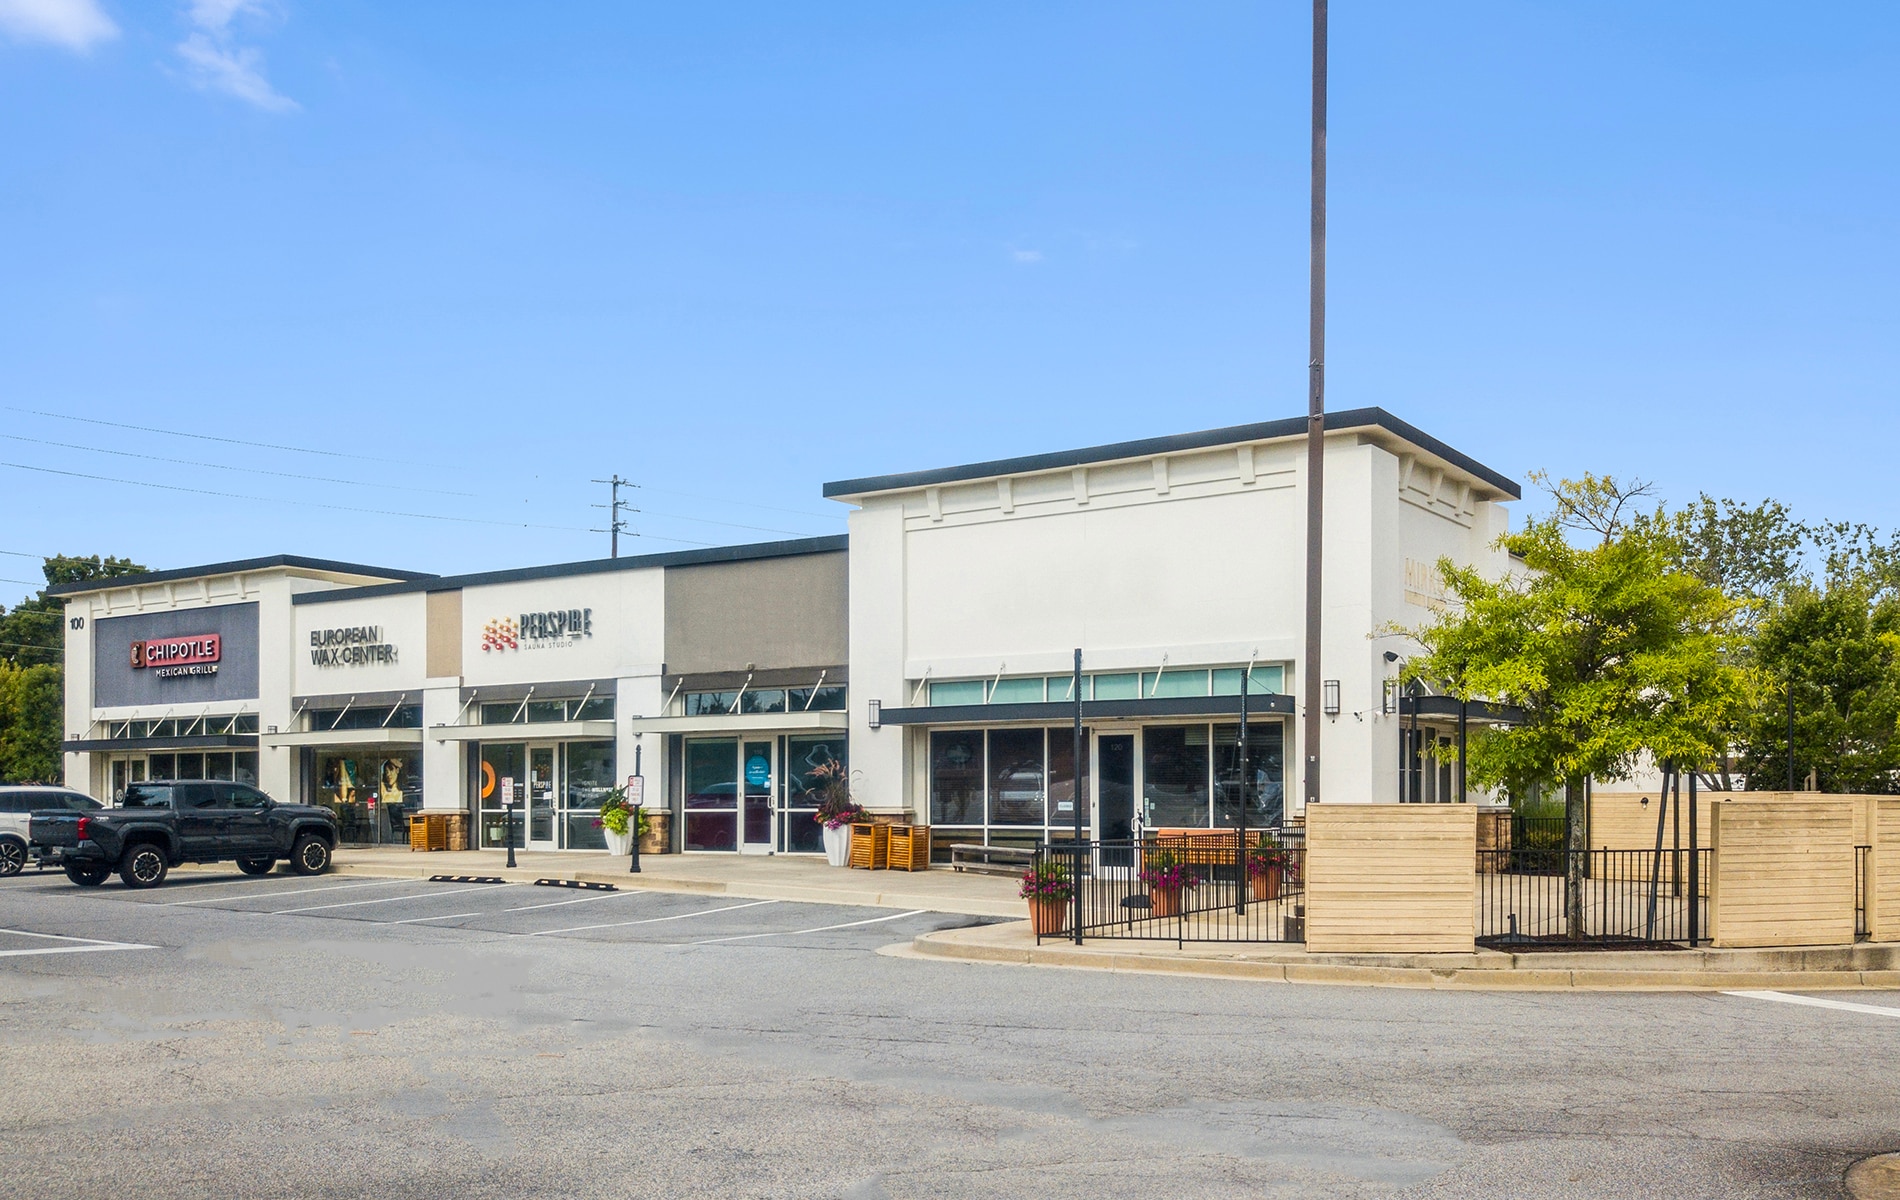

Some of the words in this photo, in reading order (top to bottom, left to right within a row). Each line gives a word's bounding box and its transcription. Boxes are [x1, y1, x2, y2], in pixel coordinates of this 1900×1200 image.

[70, 617, 85, 630] 100
[520, 608, 592, 639] PERSPIRE
[311, 625, 379, 646] EUROPEAN
[146, 640, 215, 661] CHIPOTLE
[548, 641, 573, 649] STUDIO
[311, 648, 339, 665] WAX
[342, 644, 393, 664] CENTER
[155, 667, 188, 678] MEXICAN
[190, 666, 214, 676] GRILL
[1110, 743, 1123, 751] 120
